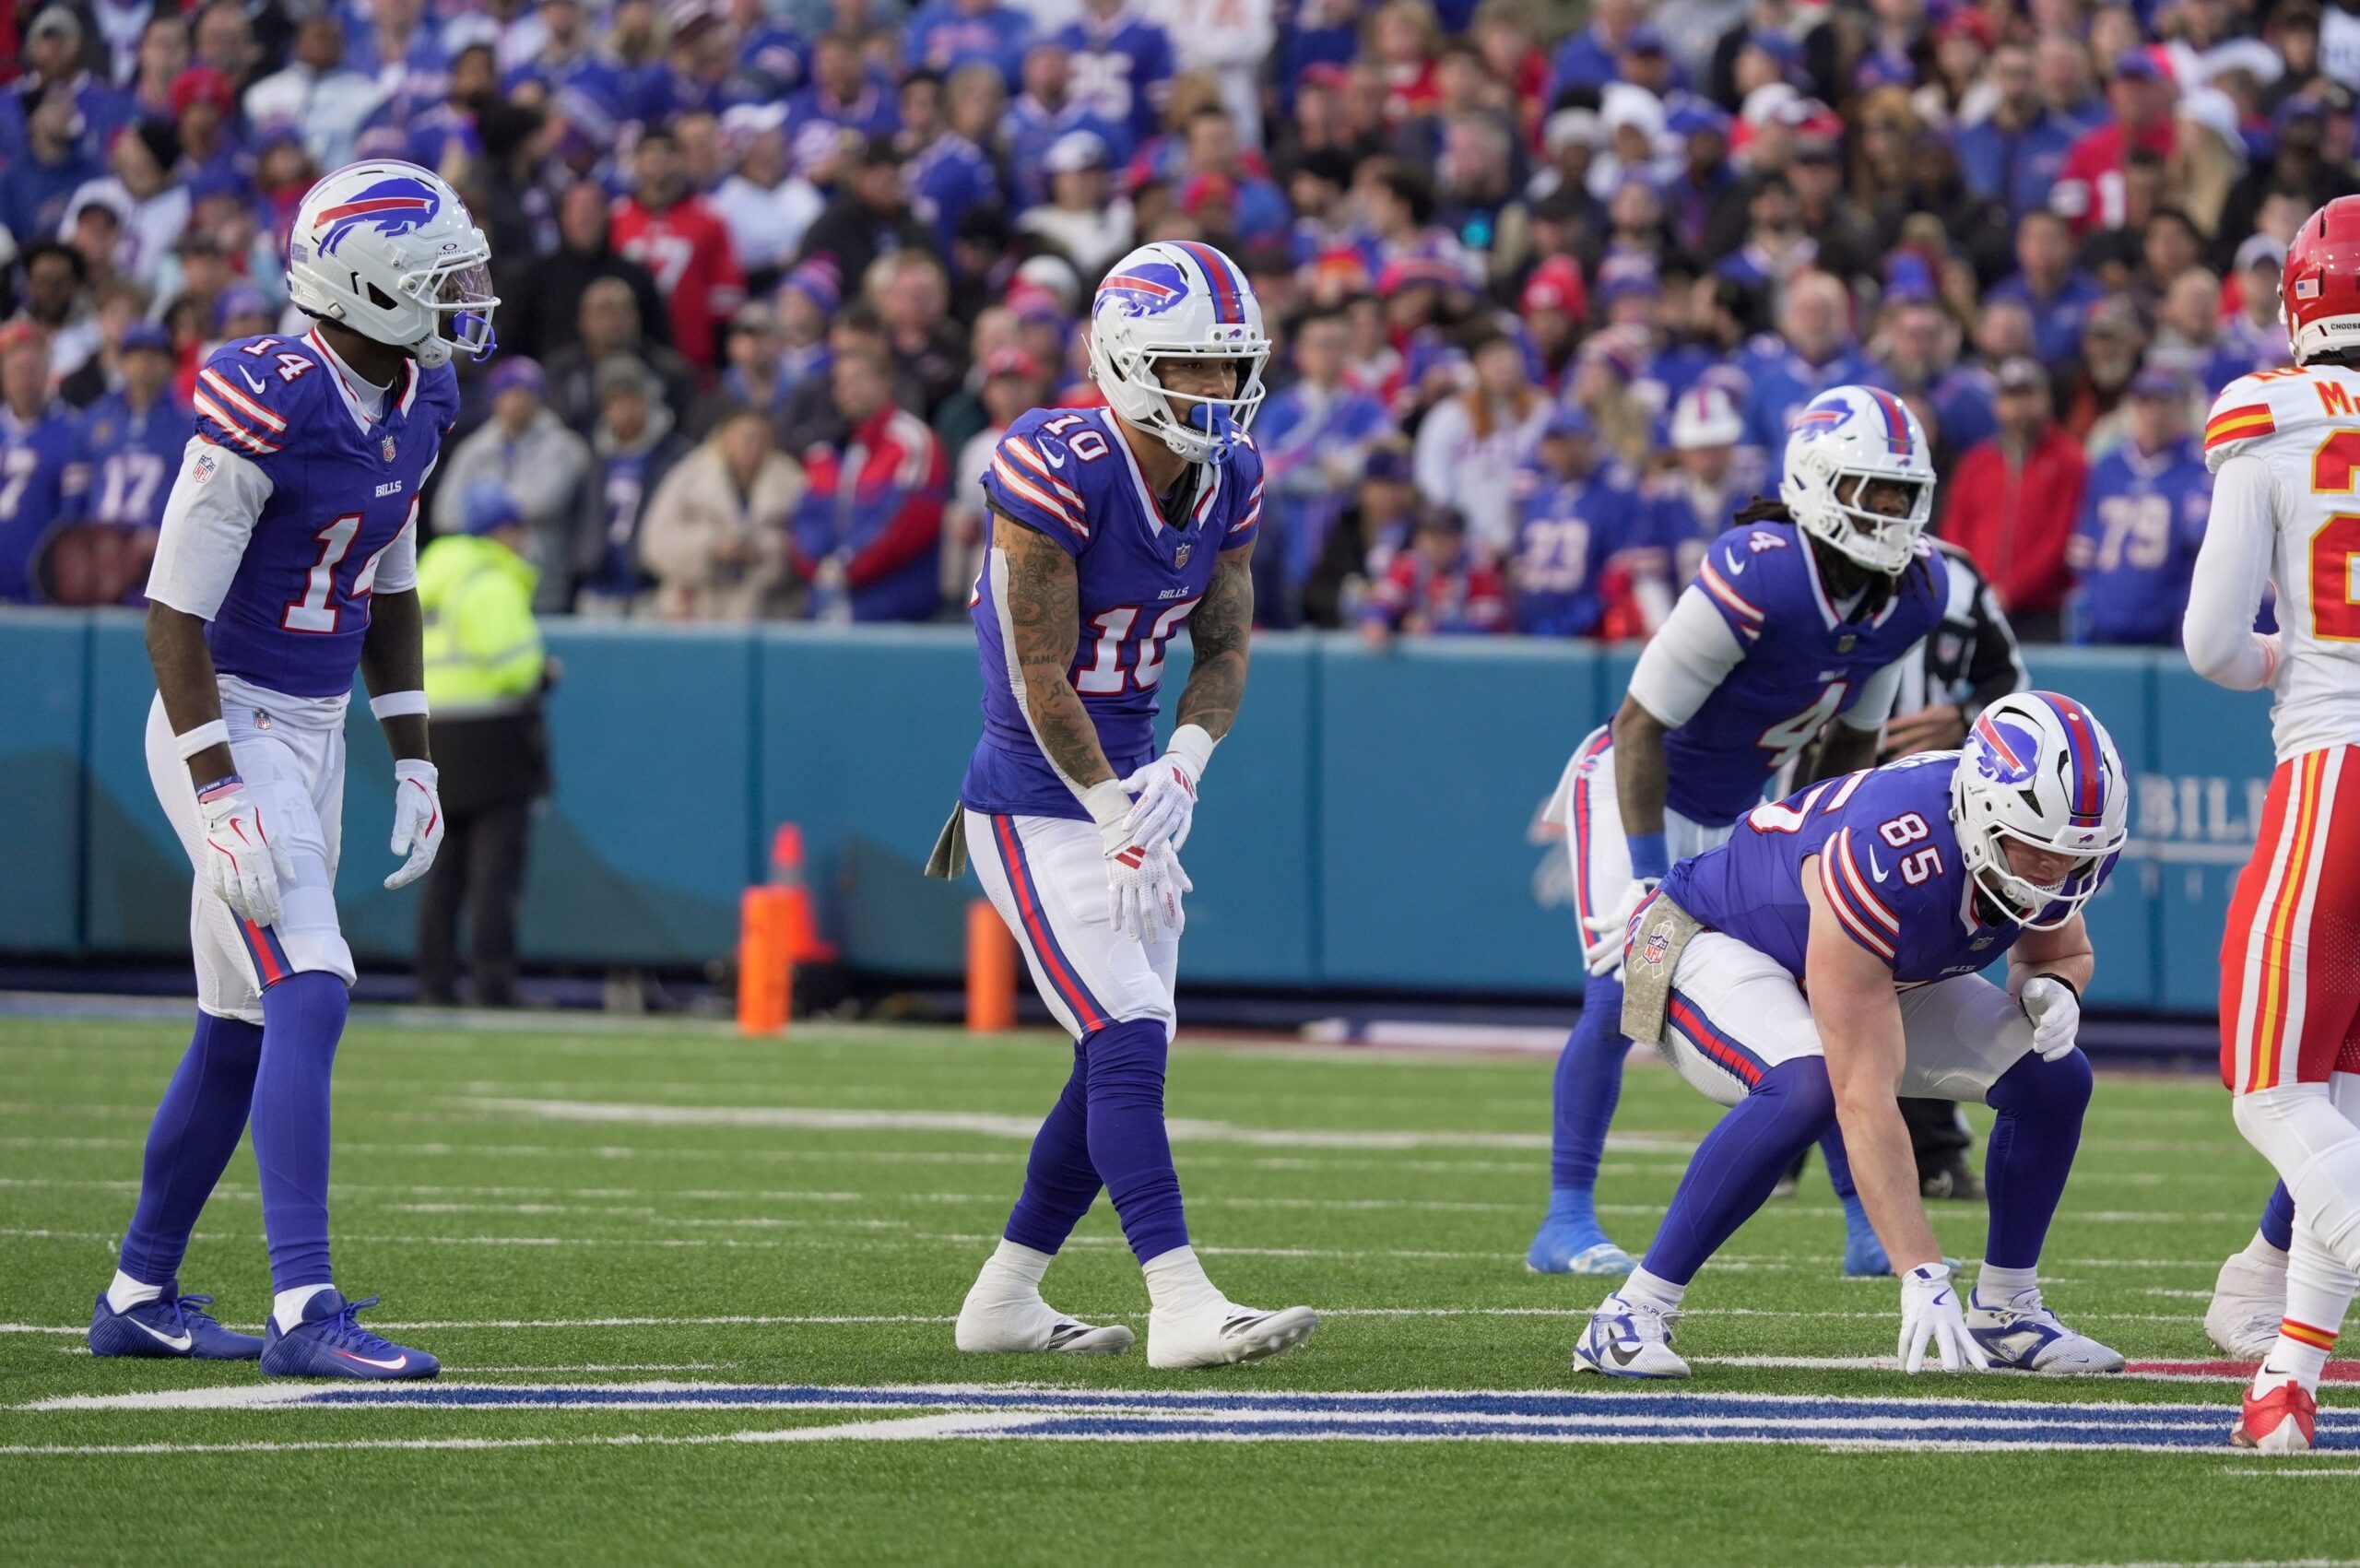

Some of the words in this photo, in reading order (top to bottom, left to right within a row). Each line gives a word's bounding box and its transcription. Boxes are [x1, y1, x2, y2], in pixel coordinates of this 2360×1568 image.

[242, 337, 314, 384] 14
[2312, 380, 2360, 419] M
[1040, 413, 1111, 463] 10
[99, 454, 164, 523] 17
[193, 463, 211, 482] NFL
[375, 480, 402, 498] BILLS
[1749, 529, 1788, 554] 4
[2097, 497, 2171, 572] 79
[280, 493, 419, 635] 14
[1158, 586, 1189, 600] BILLS
[1755, 678, 1850, 769] 4
[2137, 772, 2267, 840] BILL
[1878, 811, 1945, 887] 85
[1644, 945, 1664, 963] NFL
[1642, 1304, 1660, 1316] ALPH
